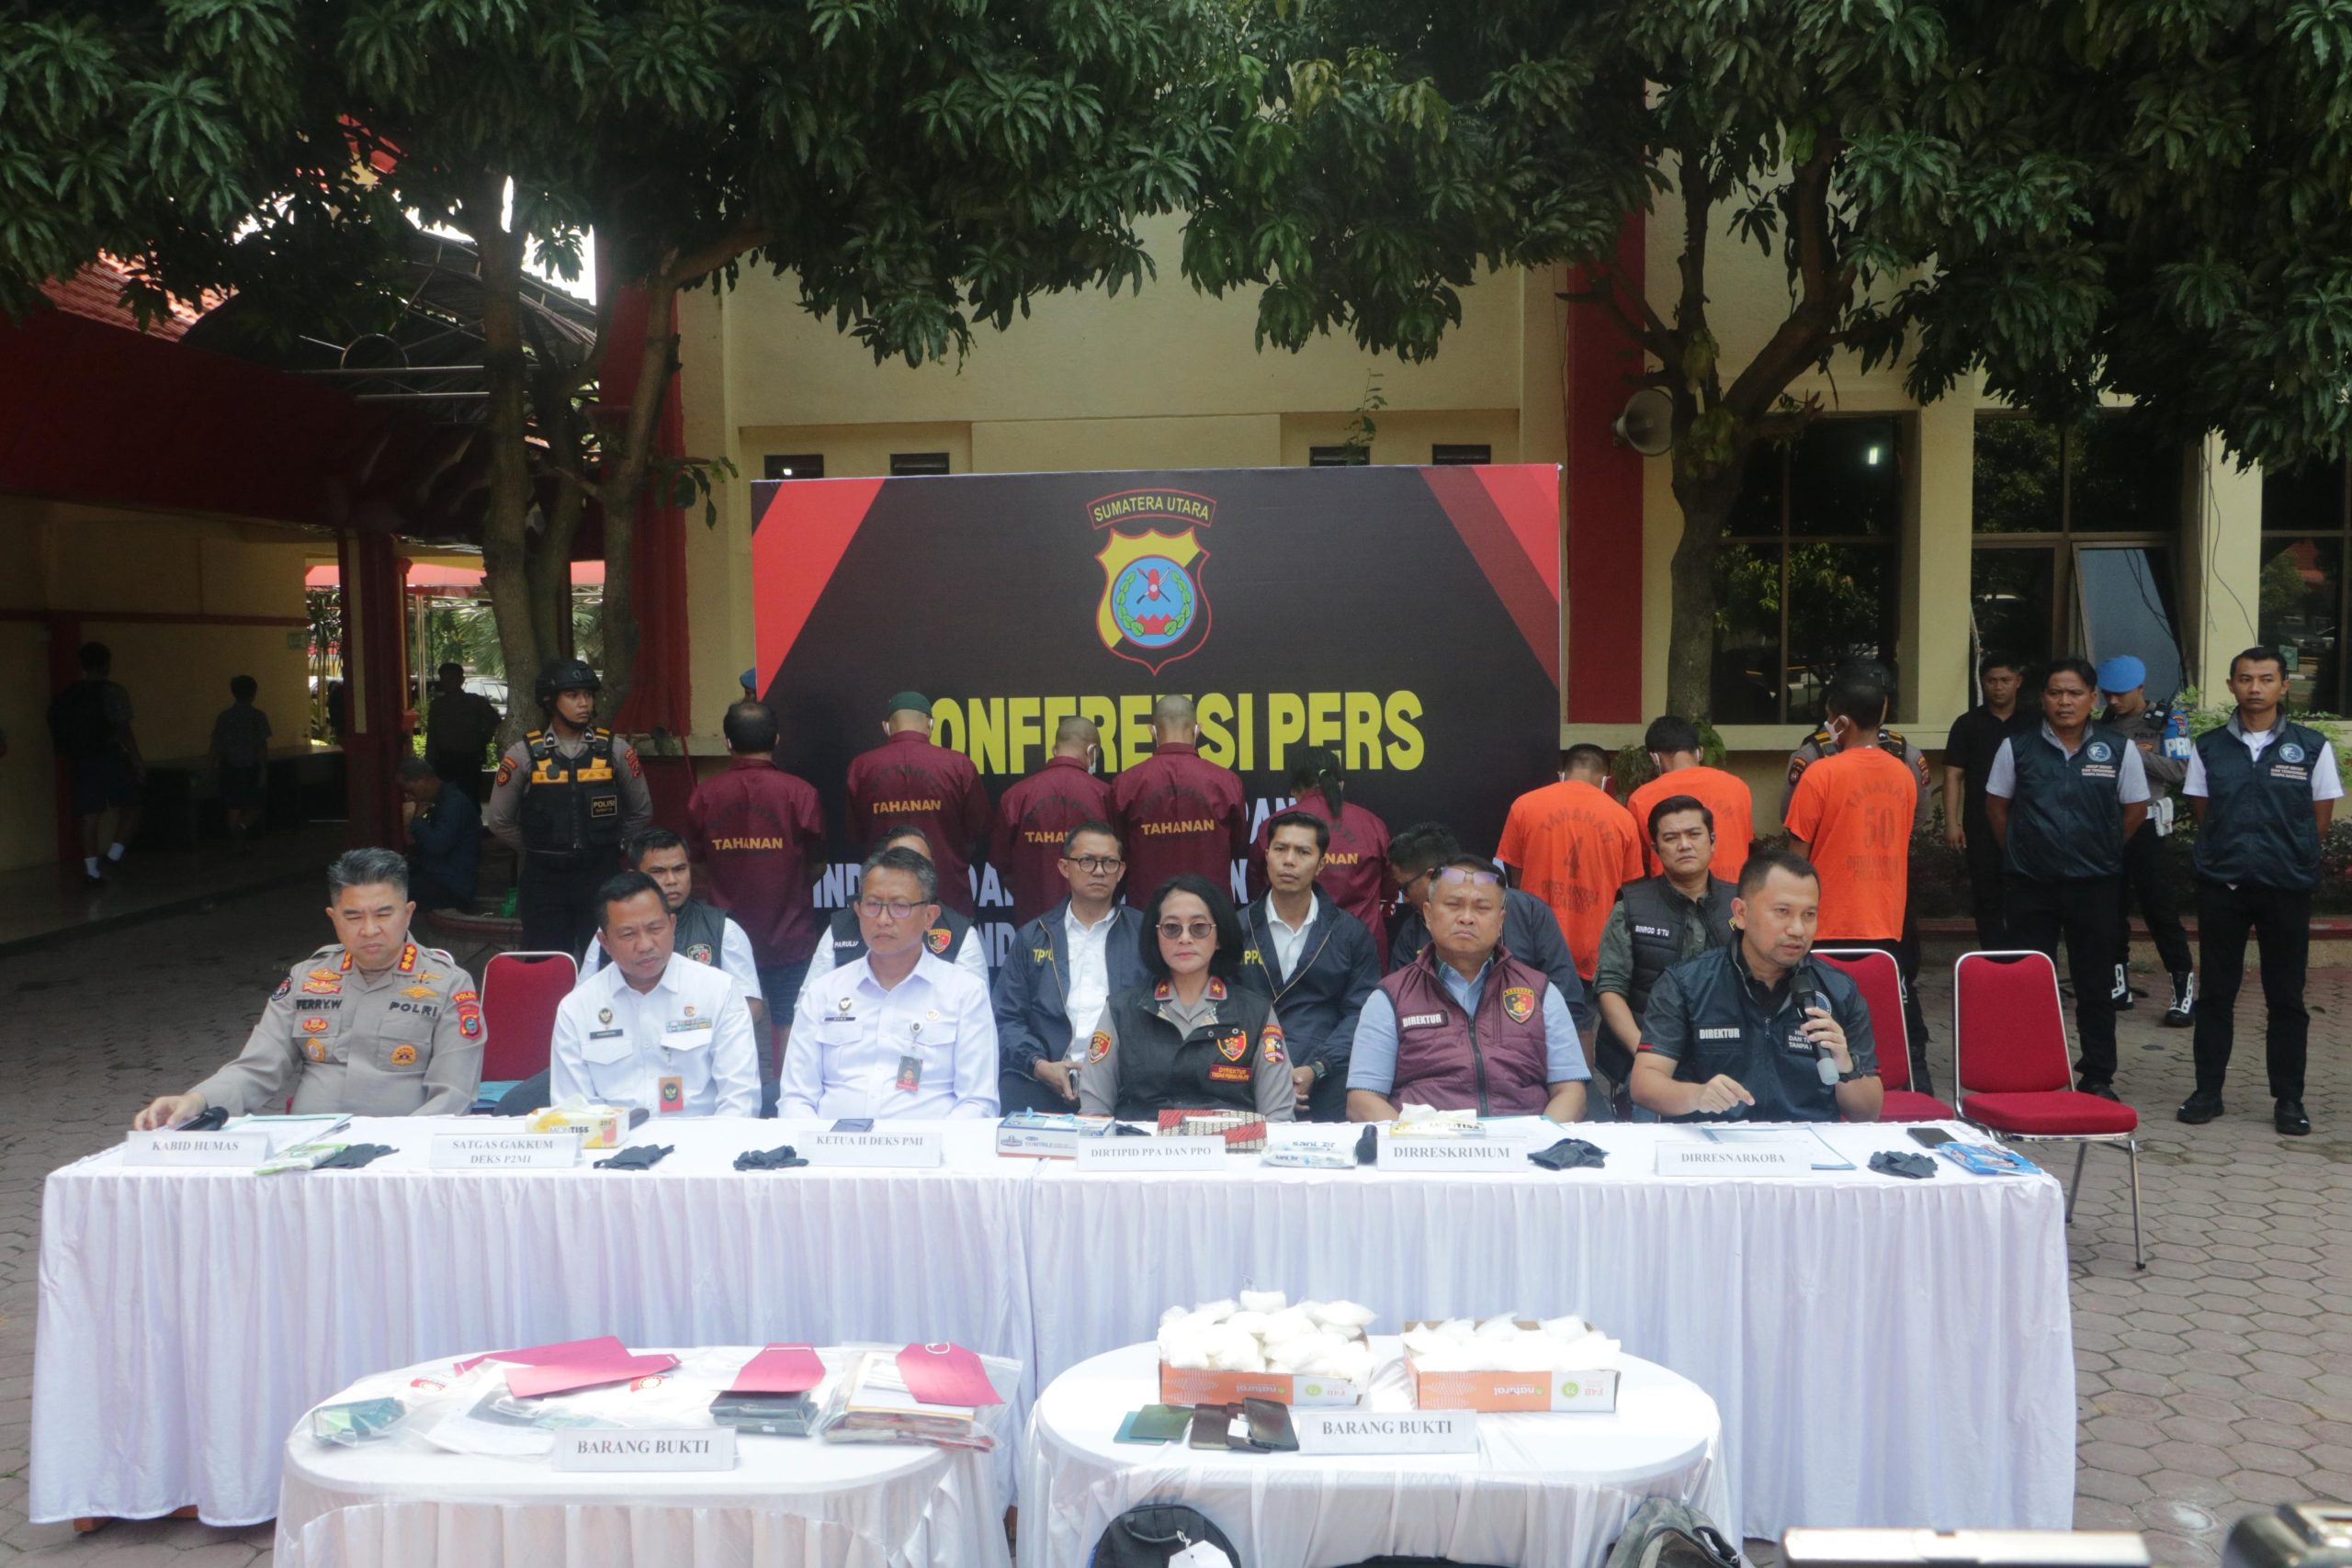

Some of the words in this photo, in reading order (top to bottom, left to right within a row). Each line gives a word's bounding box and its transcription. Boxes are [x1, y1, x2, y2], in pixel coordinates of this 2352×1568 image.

[1093, 496, 1163, 521] SUMATERA
[1167, 497, 1209, 520] UTARA
[931, 692, 1253, 774] ONFERESI
[1269, 691, 1424, 771] PERS
[872, 799, 941, 814] TAHANAN
[1141, 818, 1214, 835] TAHANAN
[1024, 831, 1068, 843] TAHA
[712, 837, 783, 851] TAHANAN
[390, 1001, 437, 1017] POLRI
[1402, 1013, 1442, 1028] DIREKTUR
[1699, 1027, 1740, 1040] DIREKTUR
[153, 1141, 191, 1151] KABID
[194, 1141, 239, 1151] HUMAS
[452, 1139, 498, 1150] SATGAS
[500, 1139, 553, 1150] GAKKUM
[816, 1135, 854, 1145] KETUA
[858, 1136, 866, 1145] II
[869, 1136, 899, 1145] DEKS
[902, 1136, 923, 1145] PMI
[1091, 1148, 1139, 1157] DIRTIPID
[1142, 1147, 1161, 1156] PPA
[1165, 1146, 1187, 1156] DAN
[1191, 1146, 1211, 1156] PPO
[1393, 1146, 1510, 1158] DIRRESKRIMUM
[470, 1155, 501, 1164] DEKS
[503, 1155, 531, 1164] P2MI
[1680, 1153, 1786, 1163] DIRRESNARKOBA
[1236, 1383, 1278, 1393] natural
[1493, 1385, 1535, 1396] natural
[1321, 1420, 1395, 1437] BARANG
[1399, 1419, 1453, 1435] BUKTI
[577, 1439, 650, 1455] BARANG
[655, 1439, 710, 1455] BUKTI
